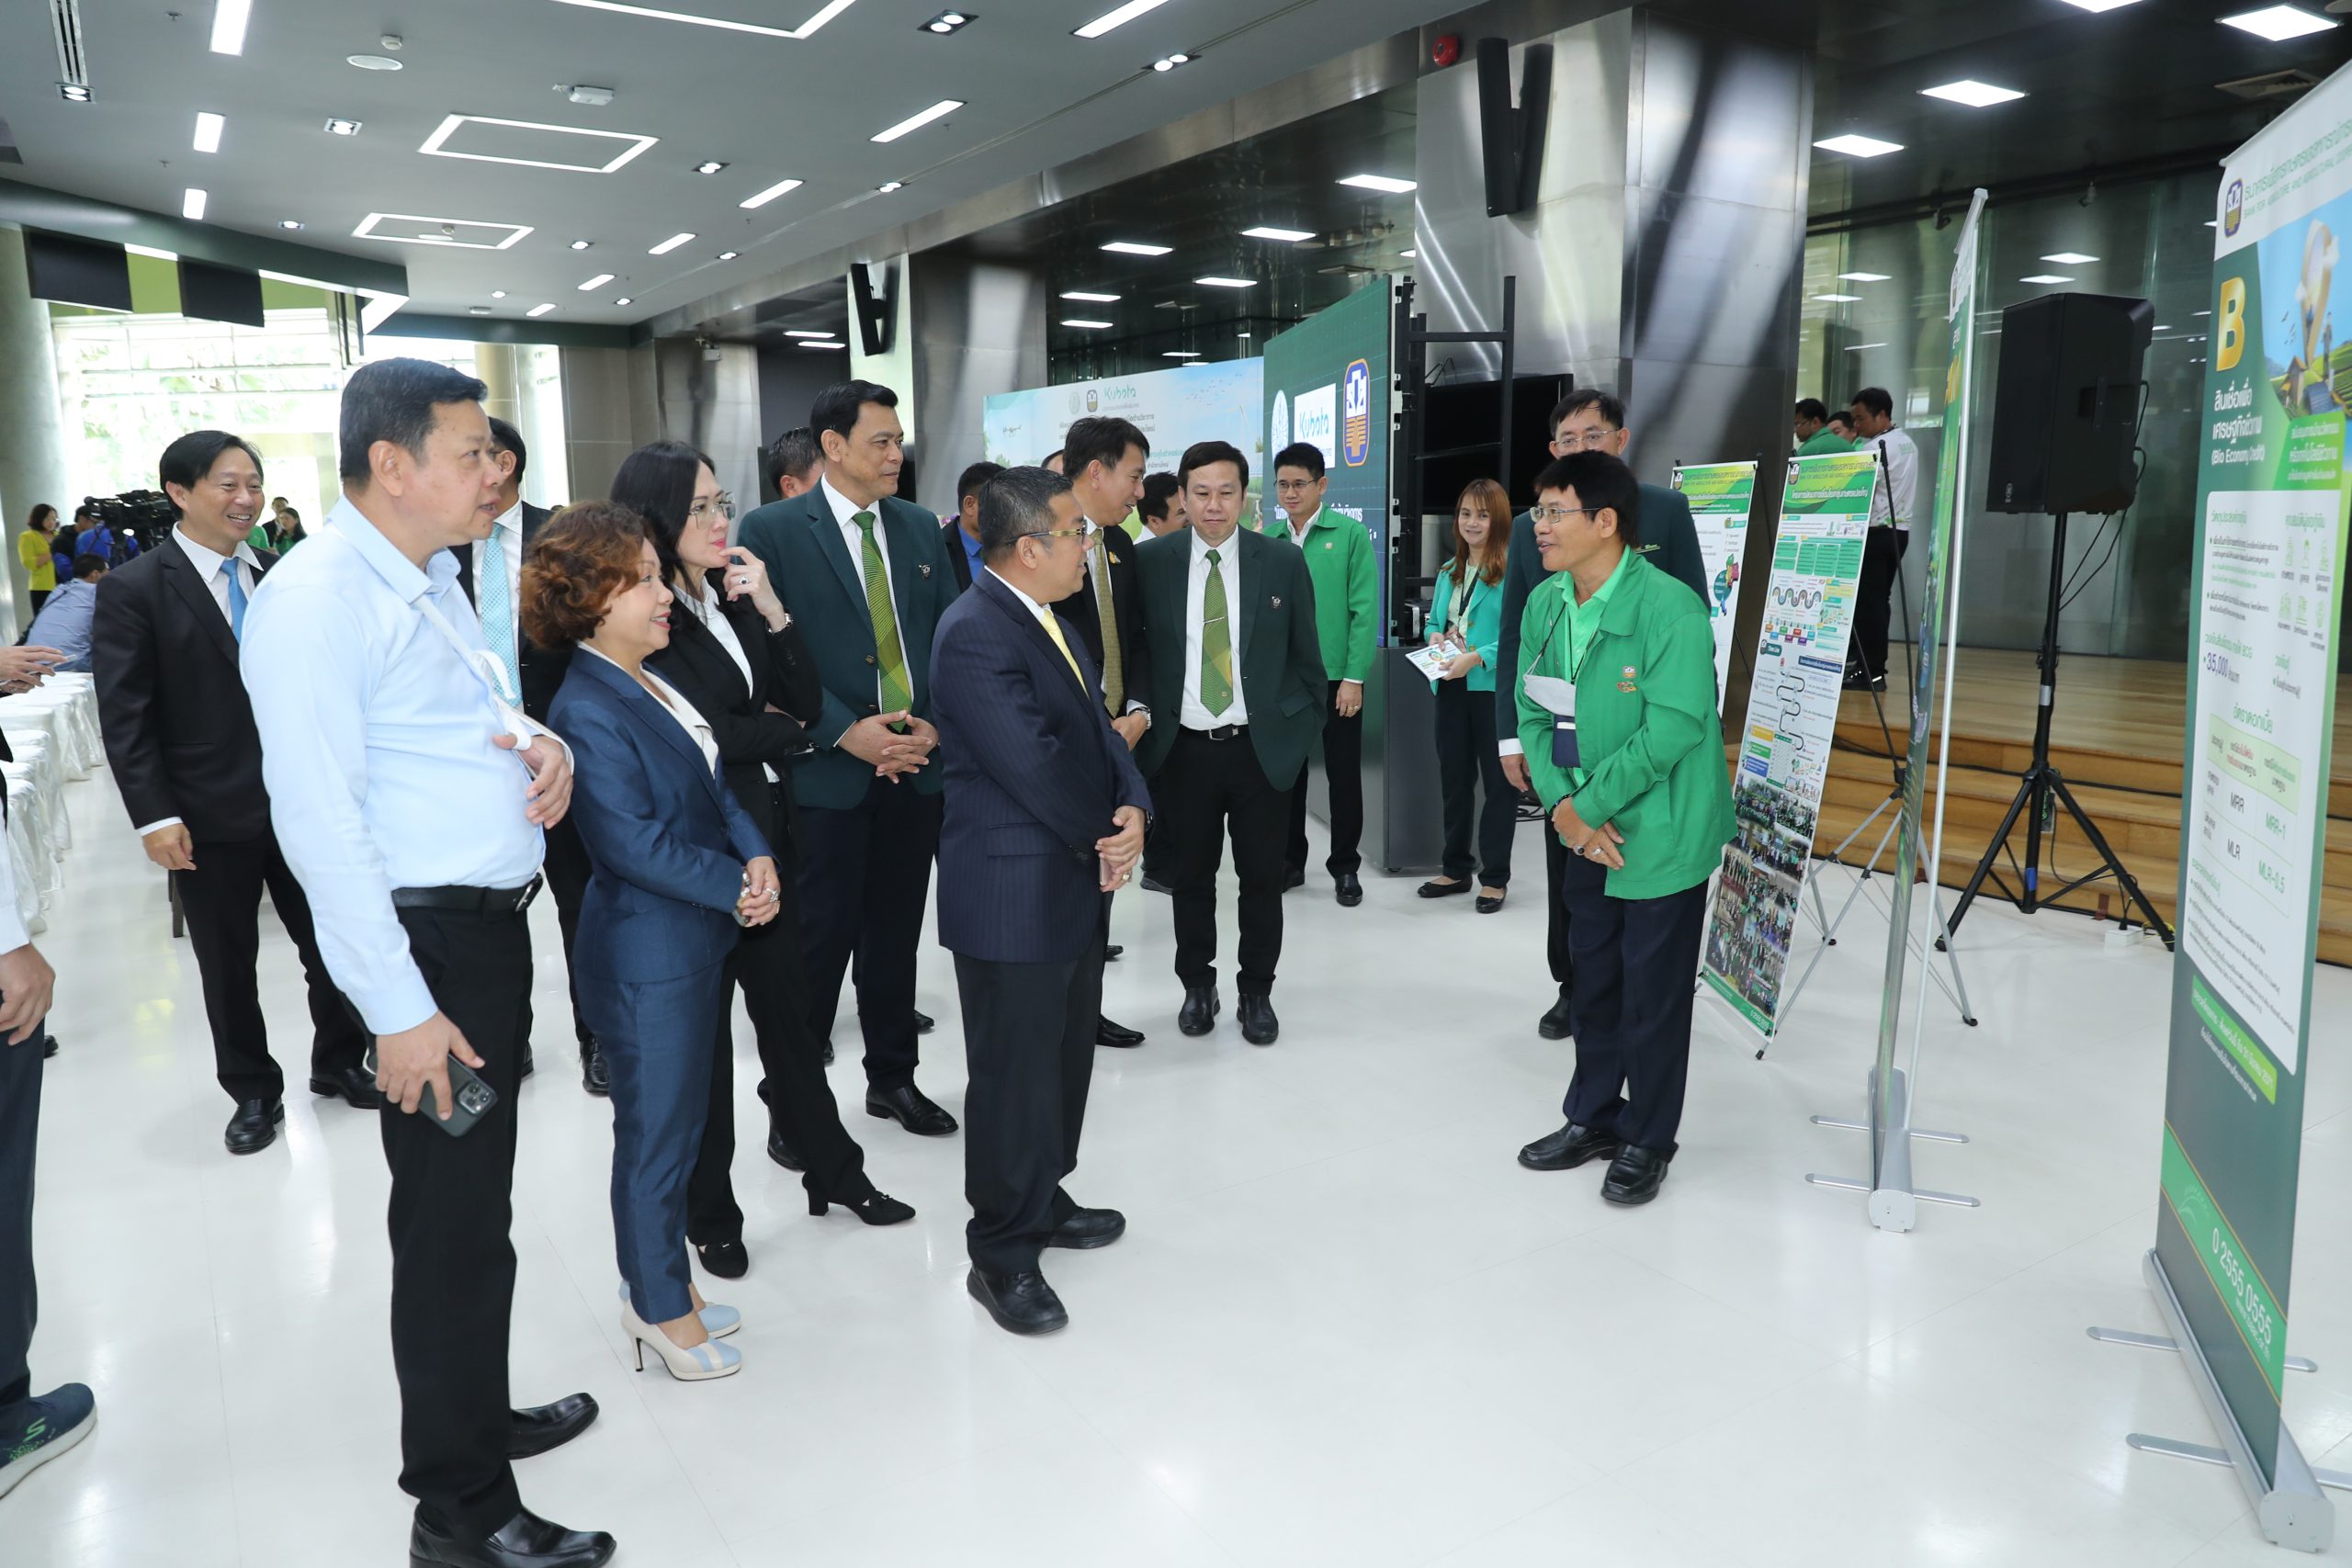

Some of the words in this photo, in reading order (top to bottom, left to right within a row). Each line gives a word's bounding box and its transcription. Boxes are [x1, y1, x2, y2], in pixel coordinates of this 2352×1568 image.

[2217, 276, 2245, 371] B
[1104, 385, 1136, 400] Kubota
[1300, 407, 1329, 439] Kubota
[2207, 652, 2229, 677] 35,000
[2212, 1227, 2220, 1254] 0
[2220, 1240, 2245, 1297] 2555
[2245, 1283, 2272, 1346] 0555
